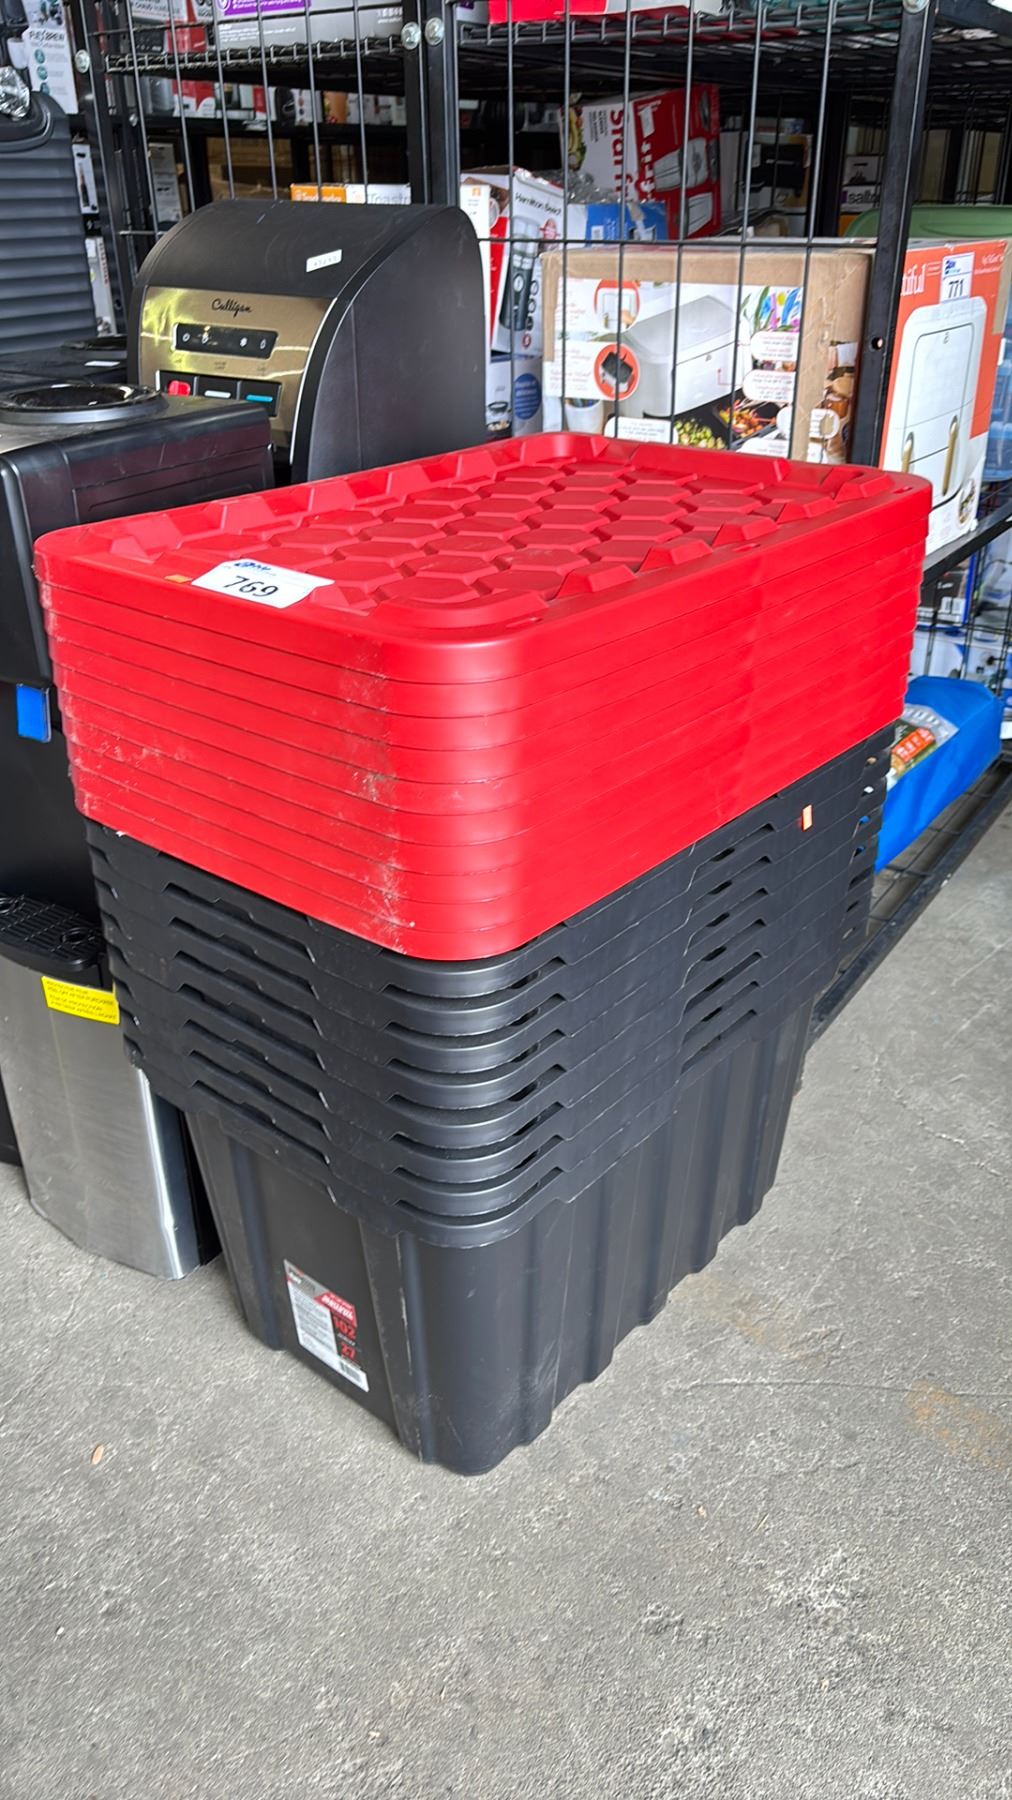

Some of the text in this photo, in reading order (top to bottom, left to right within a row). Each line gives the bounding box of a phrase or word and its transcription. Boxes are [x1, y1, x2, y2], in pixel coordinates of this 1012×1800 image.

[947, 278, 965, 299] 771
[211, 298, 253, 318] Culligan
[222, 575, 280, 598] 769
